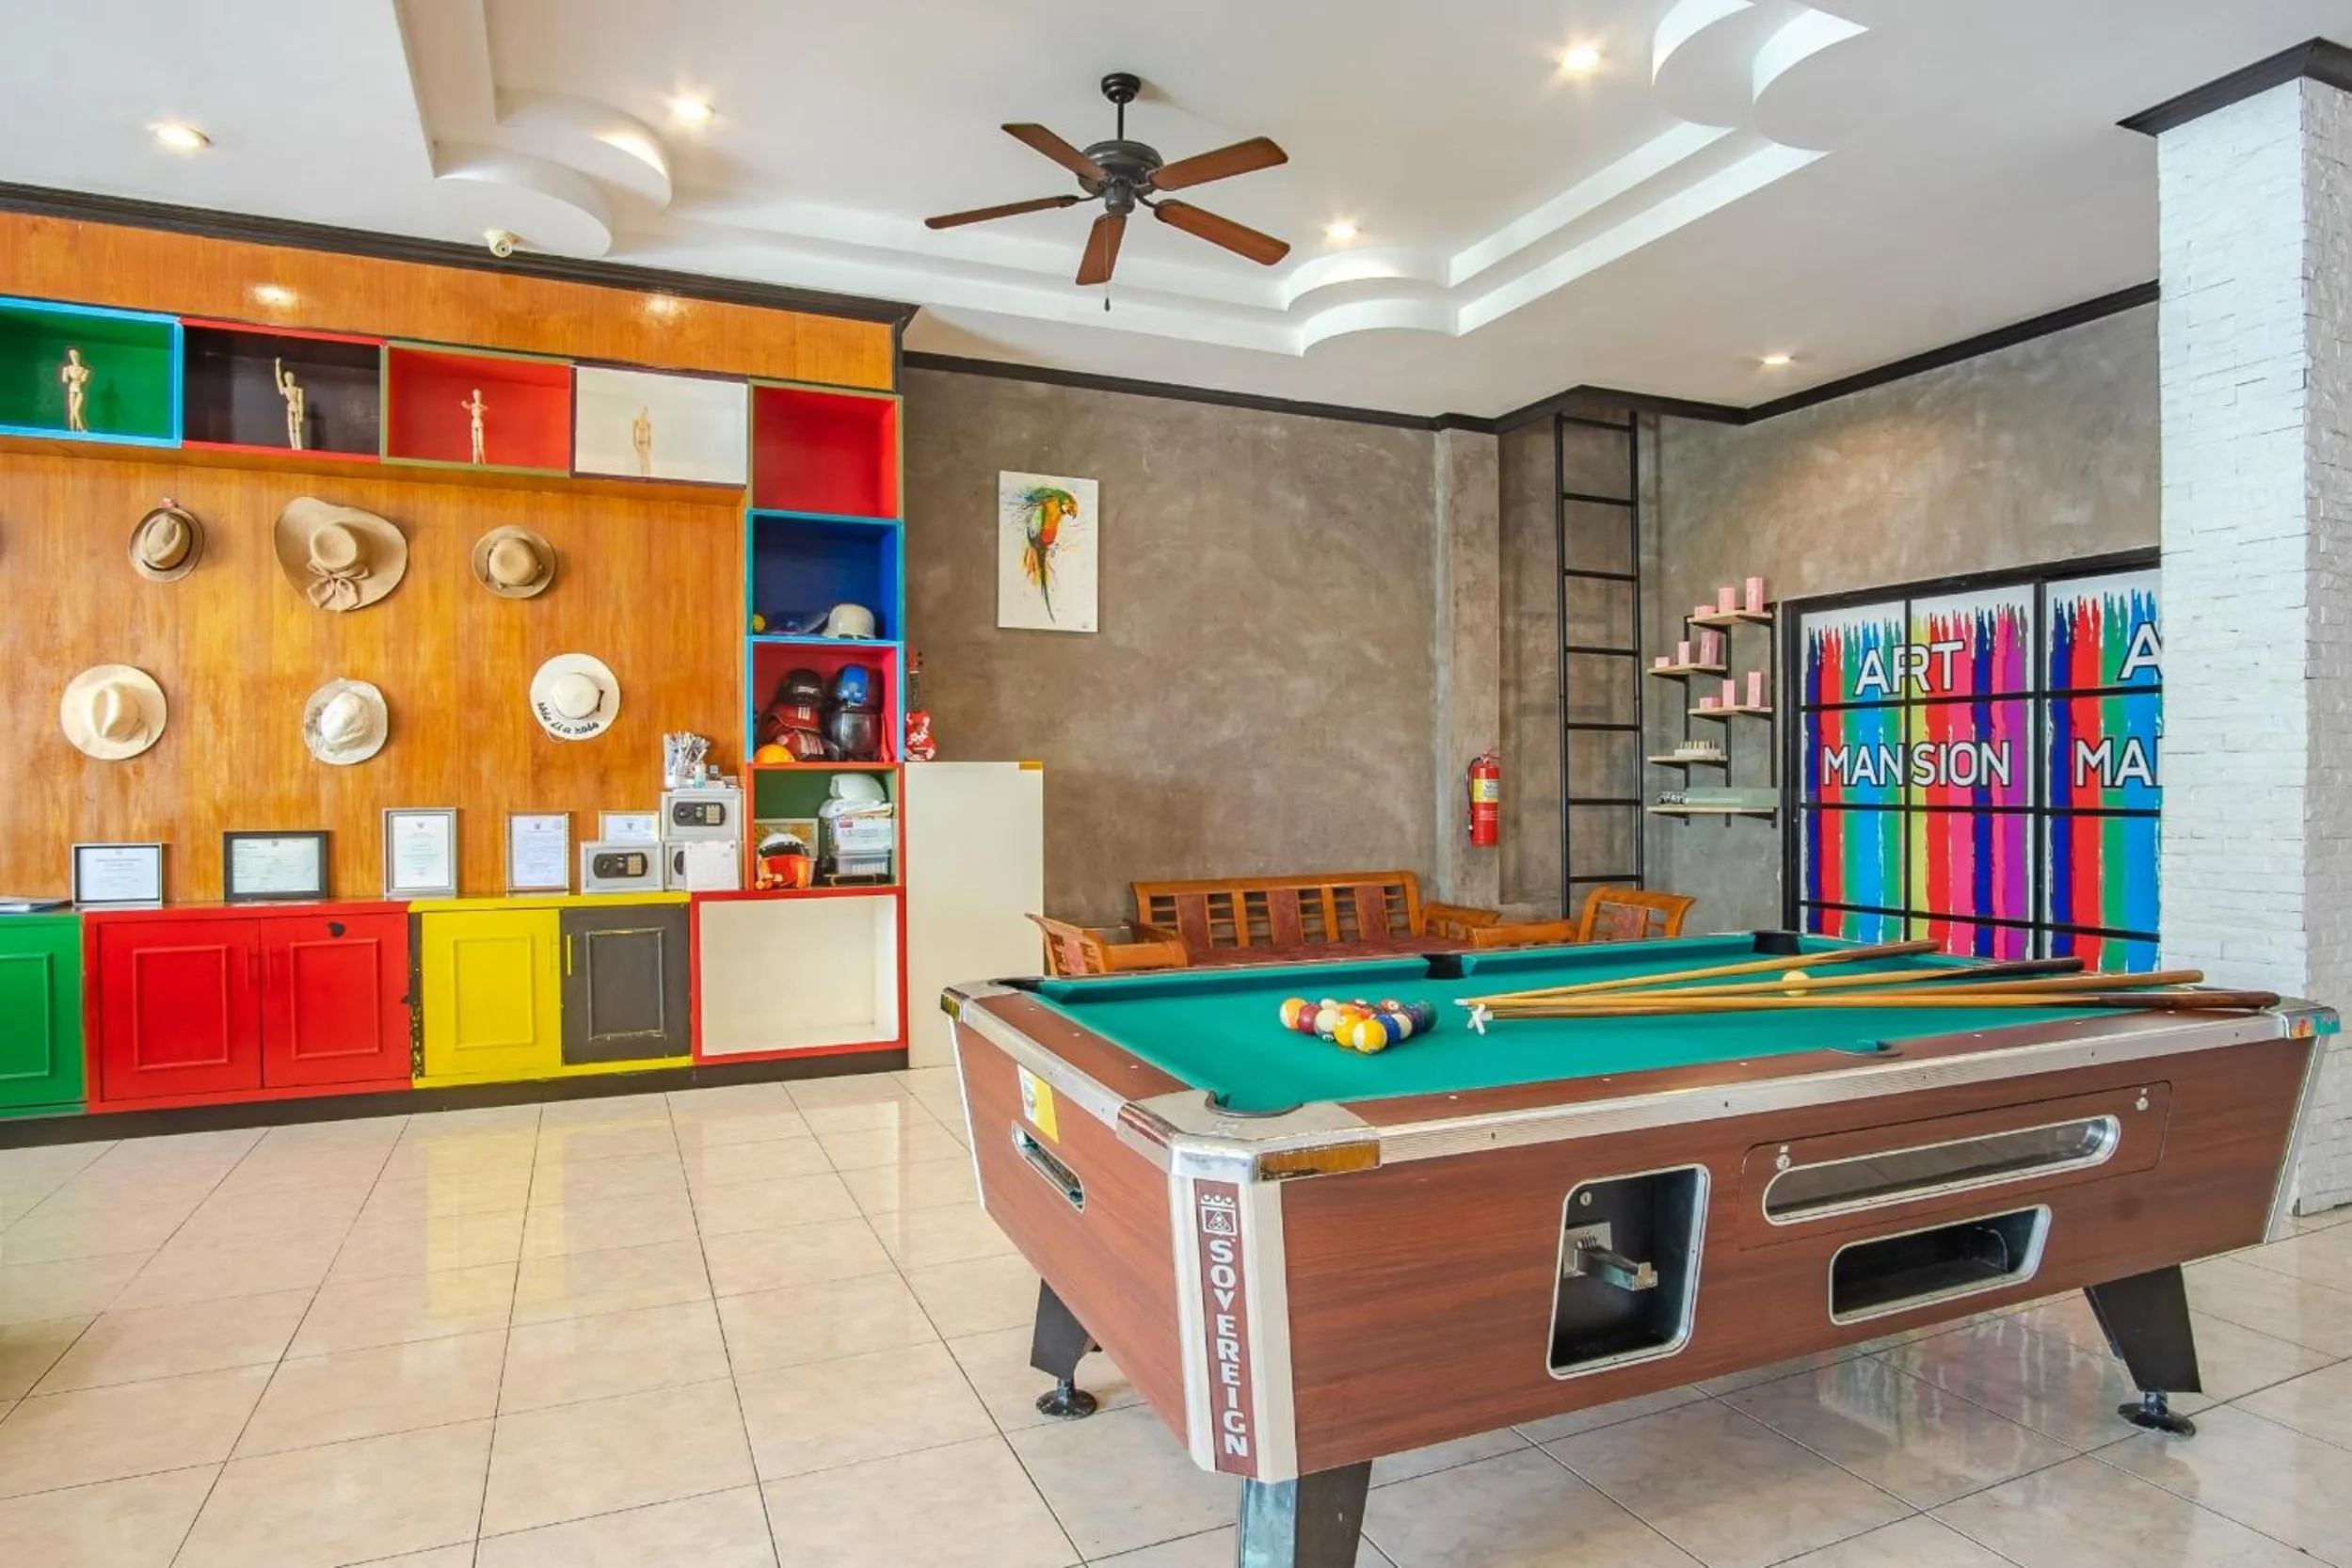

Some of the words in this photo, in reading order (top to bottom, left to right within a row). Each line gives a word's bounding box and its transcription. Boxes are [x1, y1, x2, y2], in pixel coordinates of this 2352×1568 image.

[1853, 639, 1966, 696] ART
[1823, 741, 2012, 788] MANSION
[2074, 737, 2163, 788] MA
[1209, 1240, 1249, 1457] SOVEREIGN
